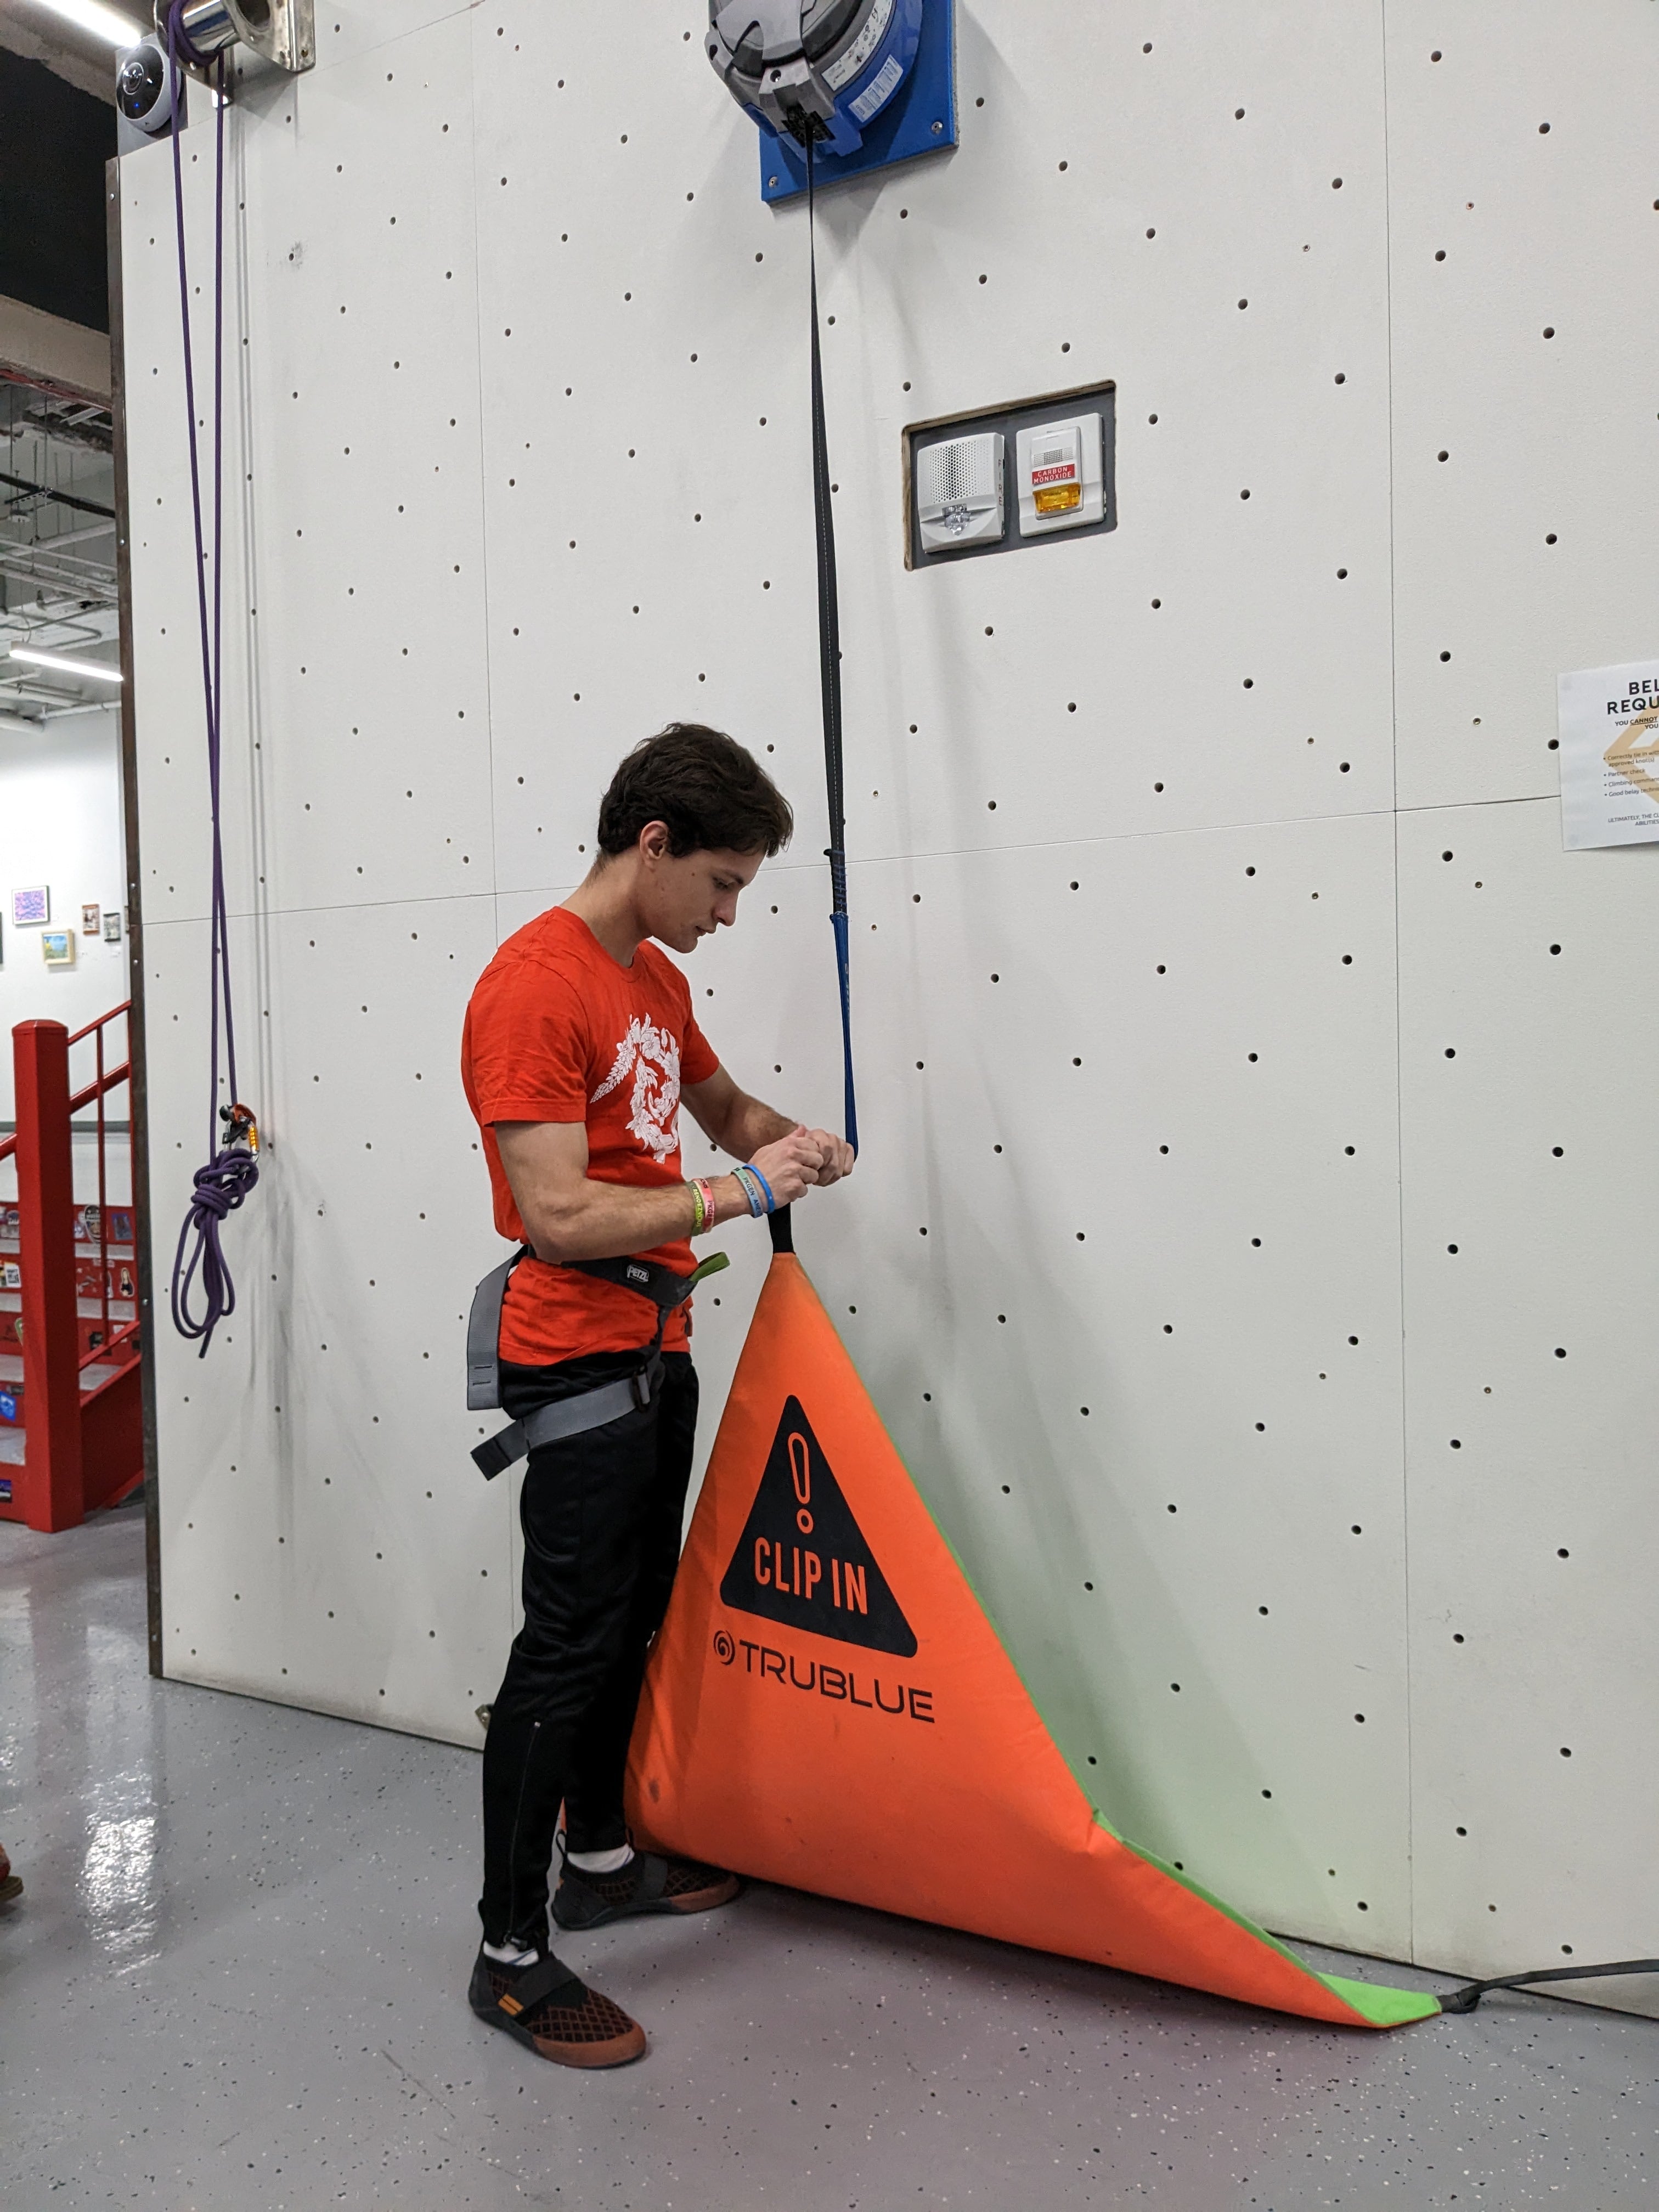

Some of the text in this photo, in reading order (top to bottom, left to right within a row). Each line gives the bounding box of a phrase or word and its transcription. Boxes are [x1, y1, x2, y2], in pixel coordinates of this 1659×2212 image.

[1034, 471, 1071, 484] MONOXIDE
[1037, 466, 1068, 477] CARBON
[1628, 679, 1659, 696] BEL
[1607, 695, 1659, 715] REQU
[1630, 716, 1658, 725] CANNOT
[1609, 759, 1634, 767] approved
[742, 1177, 755, 1196] PKGEN
[692, 1189, 703, 1227] RENDEZVOUS
[627, 1265, 648, 1282] PETZL
[755, 1537, 868, 1615] CLIP IN
[739, 1639, 935, 1723] TRUBLUE
